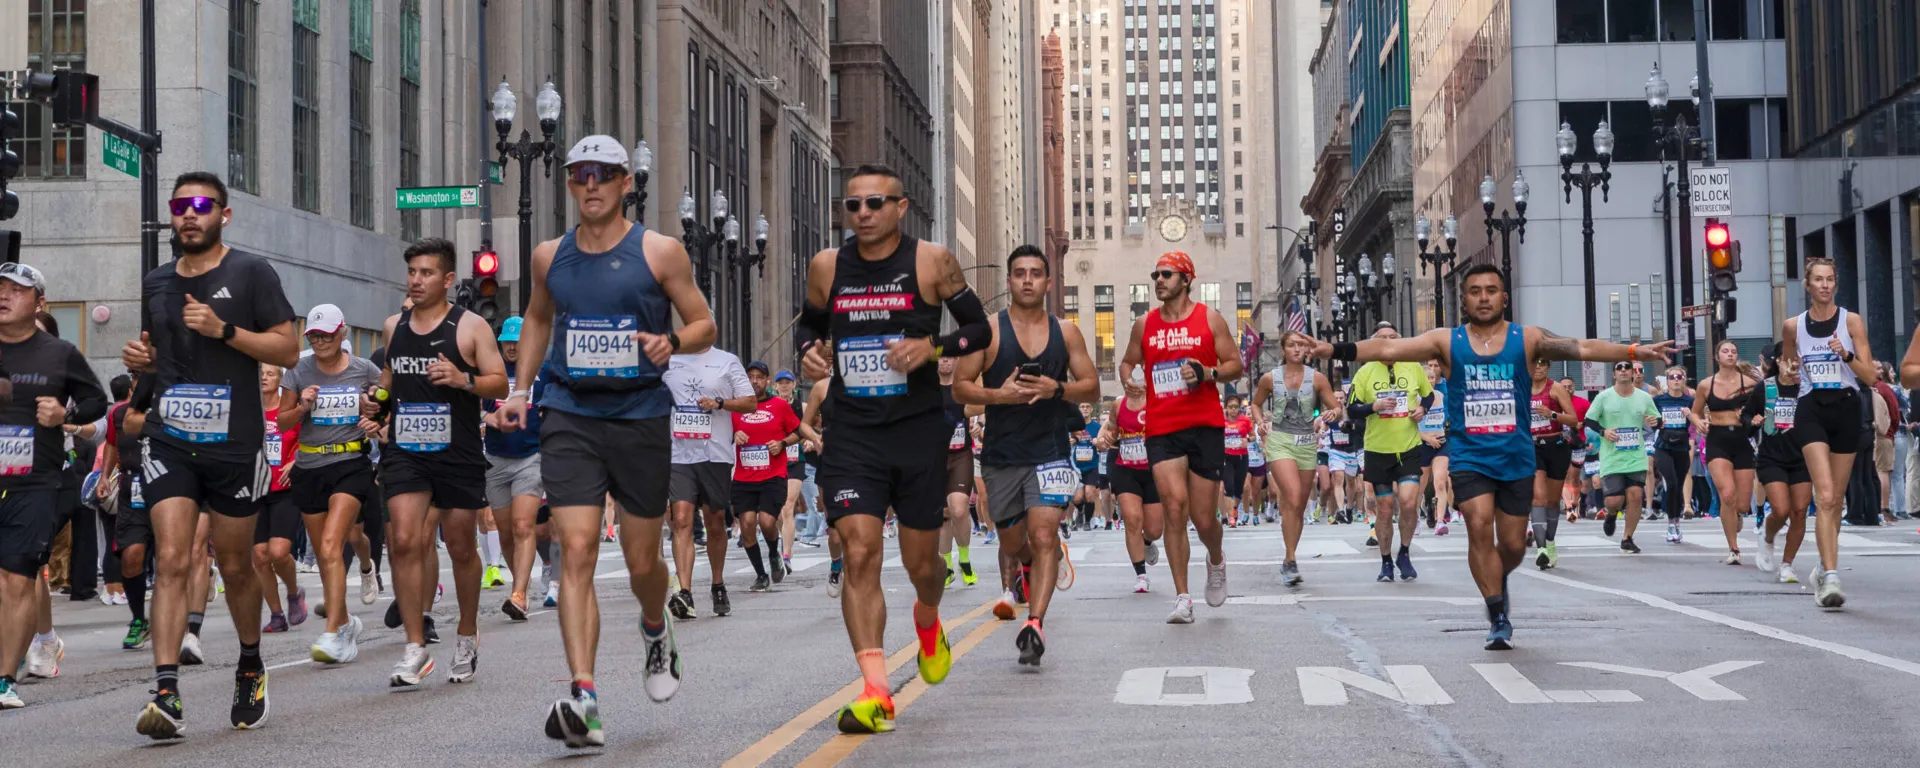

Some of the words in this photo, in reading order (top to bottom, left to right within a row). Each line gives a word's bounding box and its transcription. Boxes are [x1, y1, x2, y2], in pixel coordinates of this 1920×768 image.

[110, 135, 130, 160] LaSalle
[1693, 174, 1707, 186] DO
[1709, 173, 1728, 185] NOT
[405, 191, 450, 206] Washington
[1694, 189, 1730, 202] BLOCK
[1694, 203, 1731, 213] INTERSECTION
[873, 283, 903, 293] ULTRA
[836, 298, 868, 309] TEAM
[868, 297, 906, 307] ULTRA
[848, 309, 891, 322] MATEUS
[1166, 326, 1189, 337] ALS
[569, 333, 633, 357] J40944
[1166, 335, 1202, 347] United
[1811, 344, 1832, 352] Ashle
[390, 355, 441, 375] MEXI
[842, 353, 890, 378] J4336
[1463, 362, 1515, 381] PERU
[1153, 370, 1182, 385] H383
[1465, 379, 1515, 391] RUNNERS
[164, 400, 223, 420] J29621
[312, 395, 356, 412] J27243
[1465, 402, 1513, 418] H27821
[397, 417, 447, 436] J24993
[675, 414, 711, 426] H29493
[740, 451, 769, 461] H48603
[833, 492, 860, 503] ULTRA
[1114, 660, 1764, 706] ONLY
